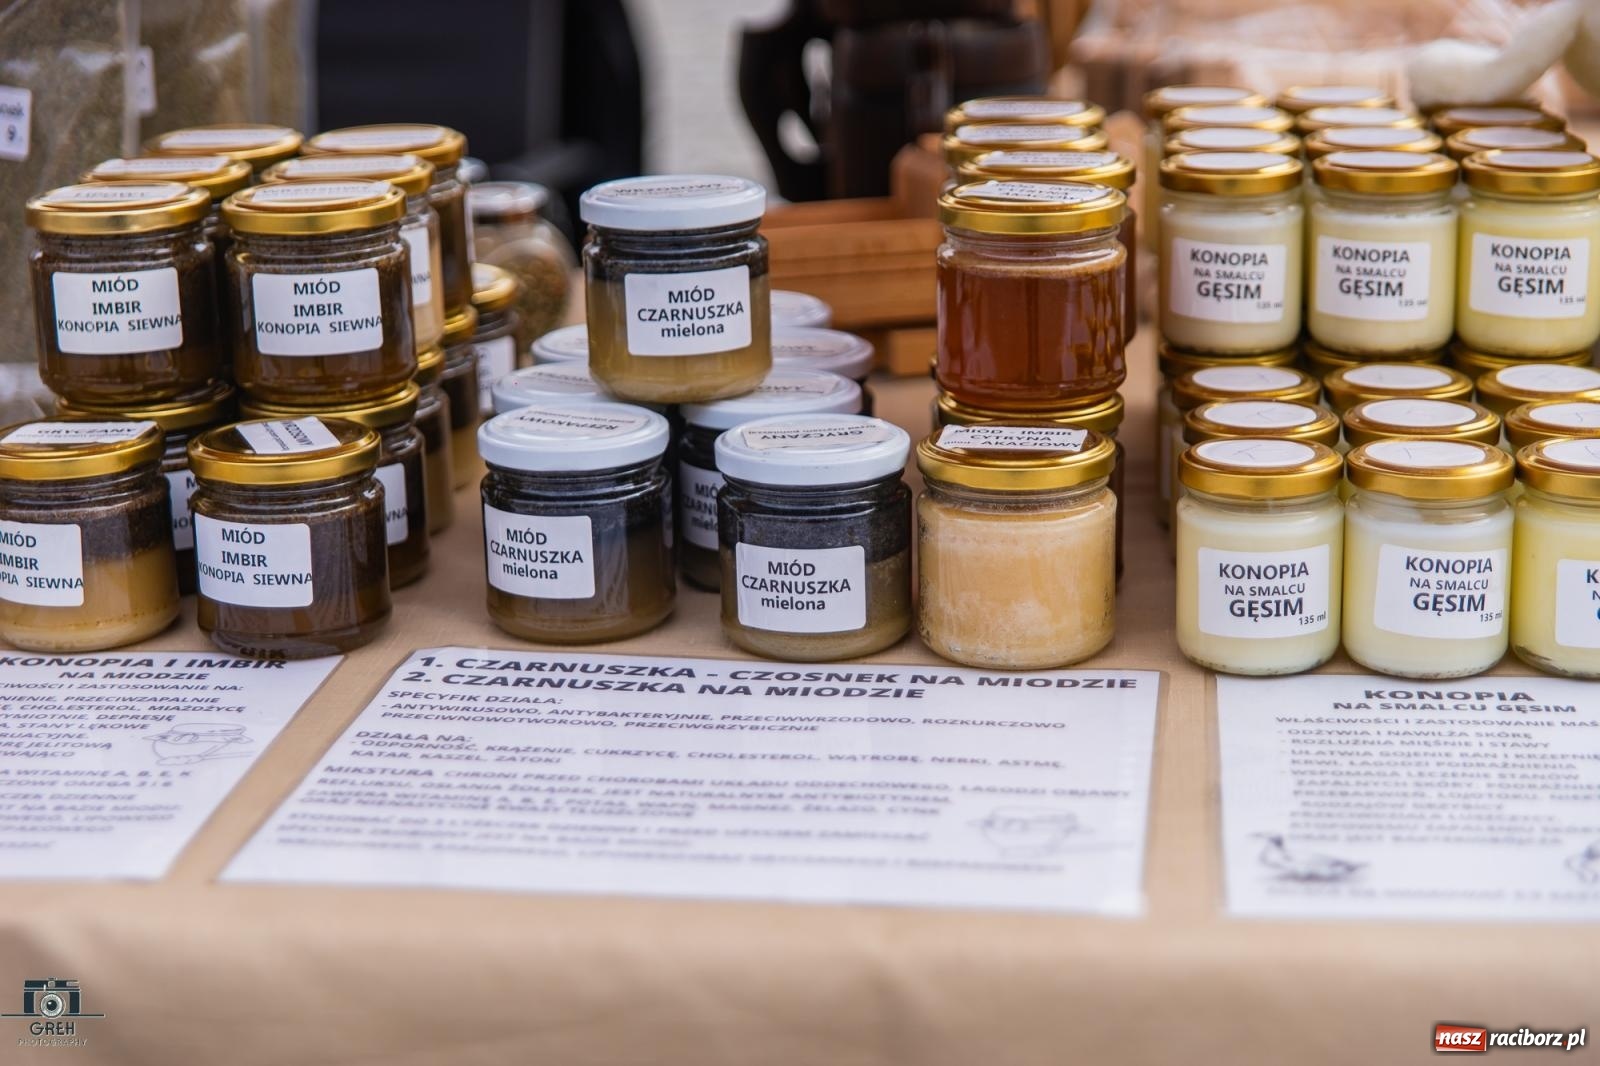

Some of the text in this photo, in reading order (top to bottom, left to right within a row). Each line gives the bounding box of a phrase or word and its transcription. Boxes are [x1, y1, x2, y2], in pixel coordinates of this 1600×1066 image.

[1190, 249, 1269, 266] KONOPIA
[1332, 245, 1410, 262] KONOPIA
[1491, 243, 1571, 260] KONOPIA
[1193, 268, 1265, 280] NA SMALCU
[1336, 264, 1407, 277] NA SMALCU
[1495, 262, 1567, 275] NA SMALCU
[92, 276, 139, 293] MIÓD
[293, 278, 341, 295] MIÓD
[1196, 280, 1262, 302] GĘSIM
[1338, 277, 1404, 299] GĘSIM
[1498, 276, 1564, 298] GĘSIM
[668, 285, 715, 304] MIÓD
[92, 300, 142, 315] IMBIR
[293, 302, 343, 317] IMBIR
[637, 301, 744, 322] CZARNUSZKA
[58, 314, 181, 333] KONOPIA SIEWNA
[257, 315, 382, 335] KONOPIA SIEWNA
[661, 323, 725, 338] mielona
[761, 430, 863, 440] GRYCZANY
[694, 481, 718, 496] MIÓ
[0, 531, 37, 548] MIÓD
[221, 527, 265, 545] MIÓD
[507, 527, 547, 545] MIÓD
[221, 551, 267, 567] IMBIR
[490, 540, 583, 564] CZARNUSZKA
[0, 553, 39, 571] IMBIR
[767, 559, 816, 577] MIÓD
[1405, 555, 1493, 574] KONOPIA
[199, 561, 312, 586] KONOPIA SIEWNA
[502, 562, 559, 580] mielona
[1219, 562, 1309, 580] KONOPIA
[26, 576, 84, 589] SIEWNA
[741, 575, 851, 595] CZARNUSZKA
[1225, 583, 1306, 597] NA SMALCU
[1410, 577, 1489, 591] NA SMALCU
[761, 595, 826, 611] mielona
[1229, 597, 1304, 622] GĘSIM
[1413, 592, 1486, 616] GĘSIM
[1299, 611, 1327, 625] 135 ml
[1480, 612, 1494, 622] 135
[0, 656, 288, 669] KONOPIA I IMBIR
[102, 672, 209, 680] MIODZIE
[419, 656, 443, 668] 1.
[455, 657, 697, 679] CZARNUSZKA
[729, 670, 899, 684] CZOSNEK
[909, 674, 965, 686] NA
[977, 676, 1138, 689] MIODZIE
[76, 683, 209, 691] ZASTOSOWANIE
[402, 671, 926, 699] 2. CZARNUSZKA NA MIODZIE
[64, 696, 220, 704] PRZECIWZAPALNIE
[387, 690, 564, 705] SPECYFIK DZIAŁA:
[1363, 689, 1537, 702] KONOPIA
[148, 704, 246, 713] MIAŻDŻYCĘ
[1332, 702, 1577, 713] NA SMALCU GĘSIM
[96, 714, 176, 722] DEPRESJĘ
[381, 711, 820, 732] PRZECIWNOWOTWOROWO, PRZECIWGRZYBICZNIE
[390, 703, 1067, 729] ANTYWIRUSOWO, ANTYBAKTERYJNIE, PRZECIWWRZODOWO, ROZKURCZOWO
[1276, 715, 1399, 724] WŁAŚCIWOŚCI
[1415, 718, 1555, 727] ZASTOSOWANIE
[17, 722, 151, 732] STANY LĘKOWE
[355, 731, 472, 742] DZIAŁA NA:
[26, 740, 112, 750] JELITOWĄ
[492, 756, 561, 765] ZATOKI
[323, 765, 434, 777] MIKSTURA
